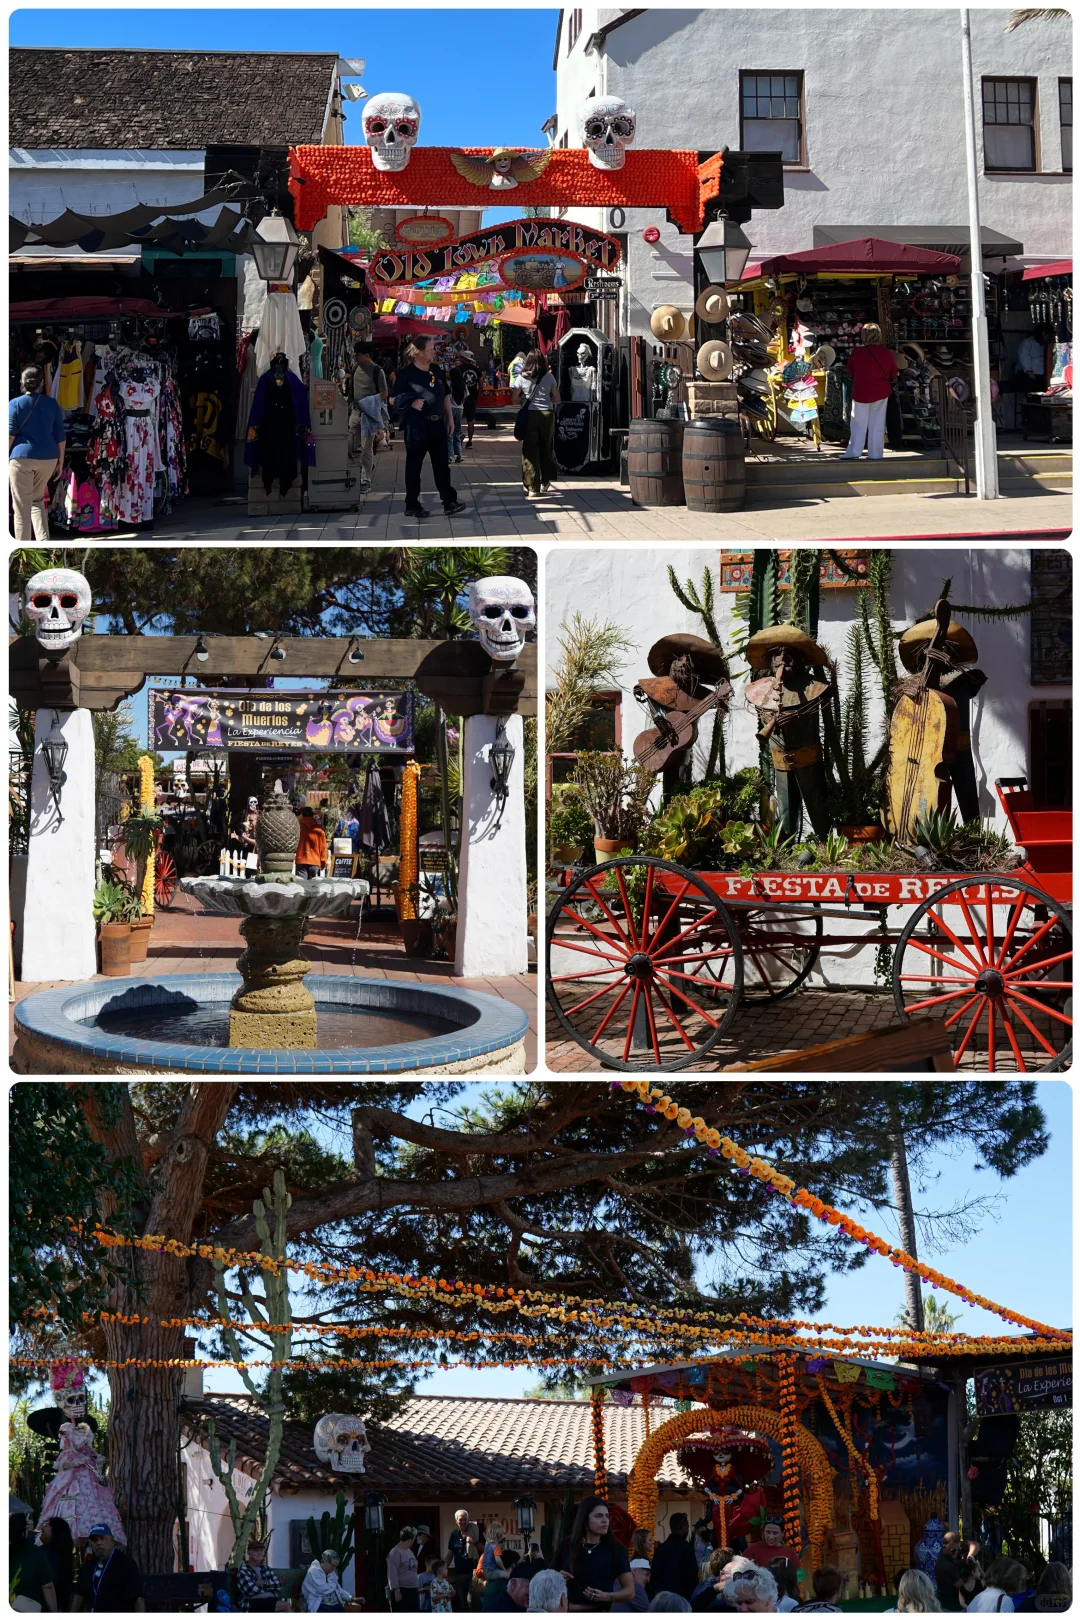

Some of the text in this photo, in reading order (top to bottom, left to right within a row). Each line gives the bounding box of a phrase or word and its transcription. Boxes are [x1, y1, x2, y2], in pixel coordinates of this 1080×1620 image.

[375, 252, 432, 281] Old
[434, 235, 506, 271] Town
[587, 277, 620, 288] Restrooms
[259, 701, 272, 712] de
[274, 700, 292, 712] los
[241, 713, 289, 727] Muertos
[227, 727, 241, 736] La
[271, 740, 303, 748] REYES
[724, 877, 846, 897] FIESTA
[854, 882, 890, 897] DE
[1019, 1367, 1033, 1379] Dia
[1034, 1366, 1044, 1377] de
[1045, 1364, 1058, 1376] los
[1018, 1382, 1033, 1394] La
